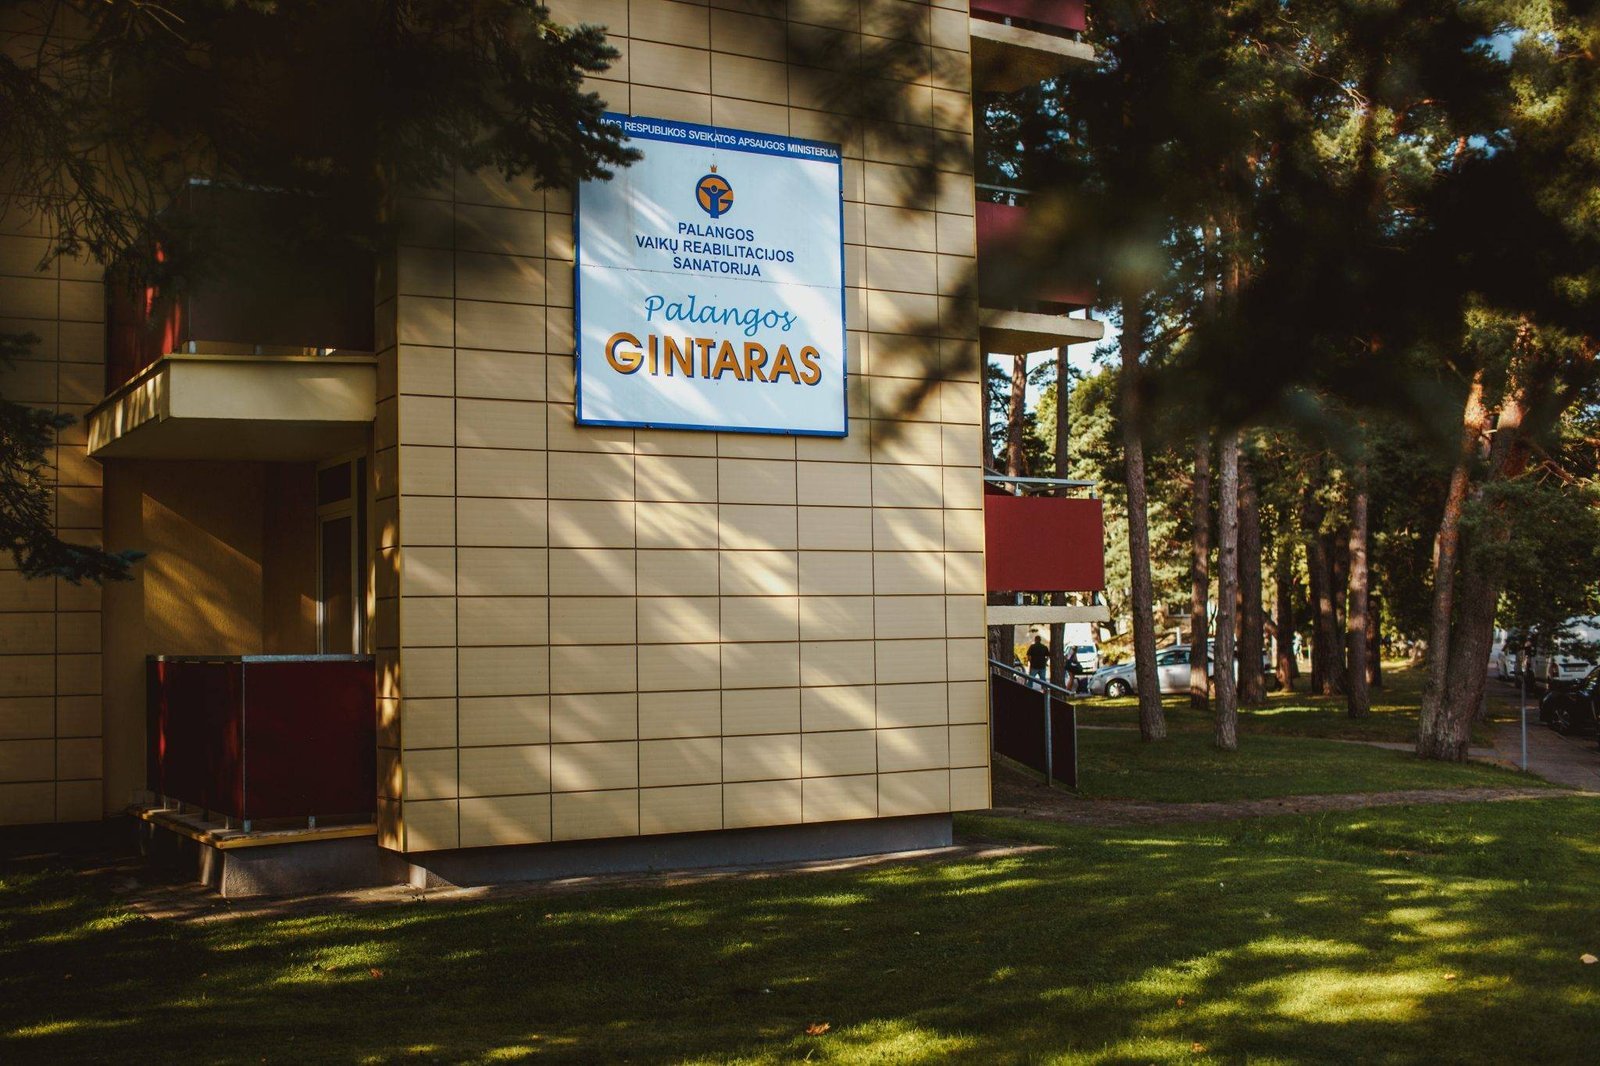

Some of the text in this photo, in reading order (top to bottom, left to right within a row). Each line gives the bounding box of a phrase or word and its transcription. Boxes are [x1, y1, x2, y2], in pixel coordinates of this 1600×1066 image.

[624, 121, 686, 138] RESPUBLIKOS
[688, 130, 736, 145] SVEIKATOS
[738, 136, 786, 152] APSAUGOS
[787, 143, 839, 159] MINISTERIJA
[678, 222, 754, 242] PALANGOS
[636, 235, 795, 263] VAIKŲ REABILITACIJOS
[673, 256, 761, 277] SANATORIJA
[645, 295, 797, 337] Palangos
[605, 332, 822, 386] GINTARAS
